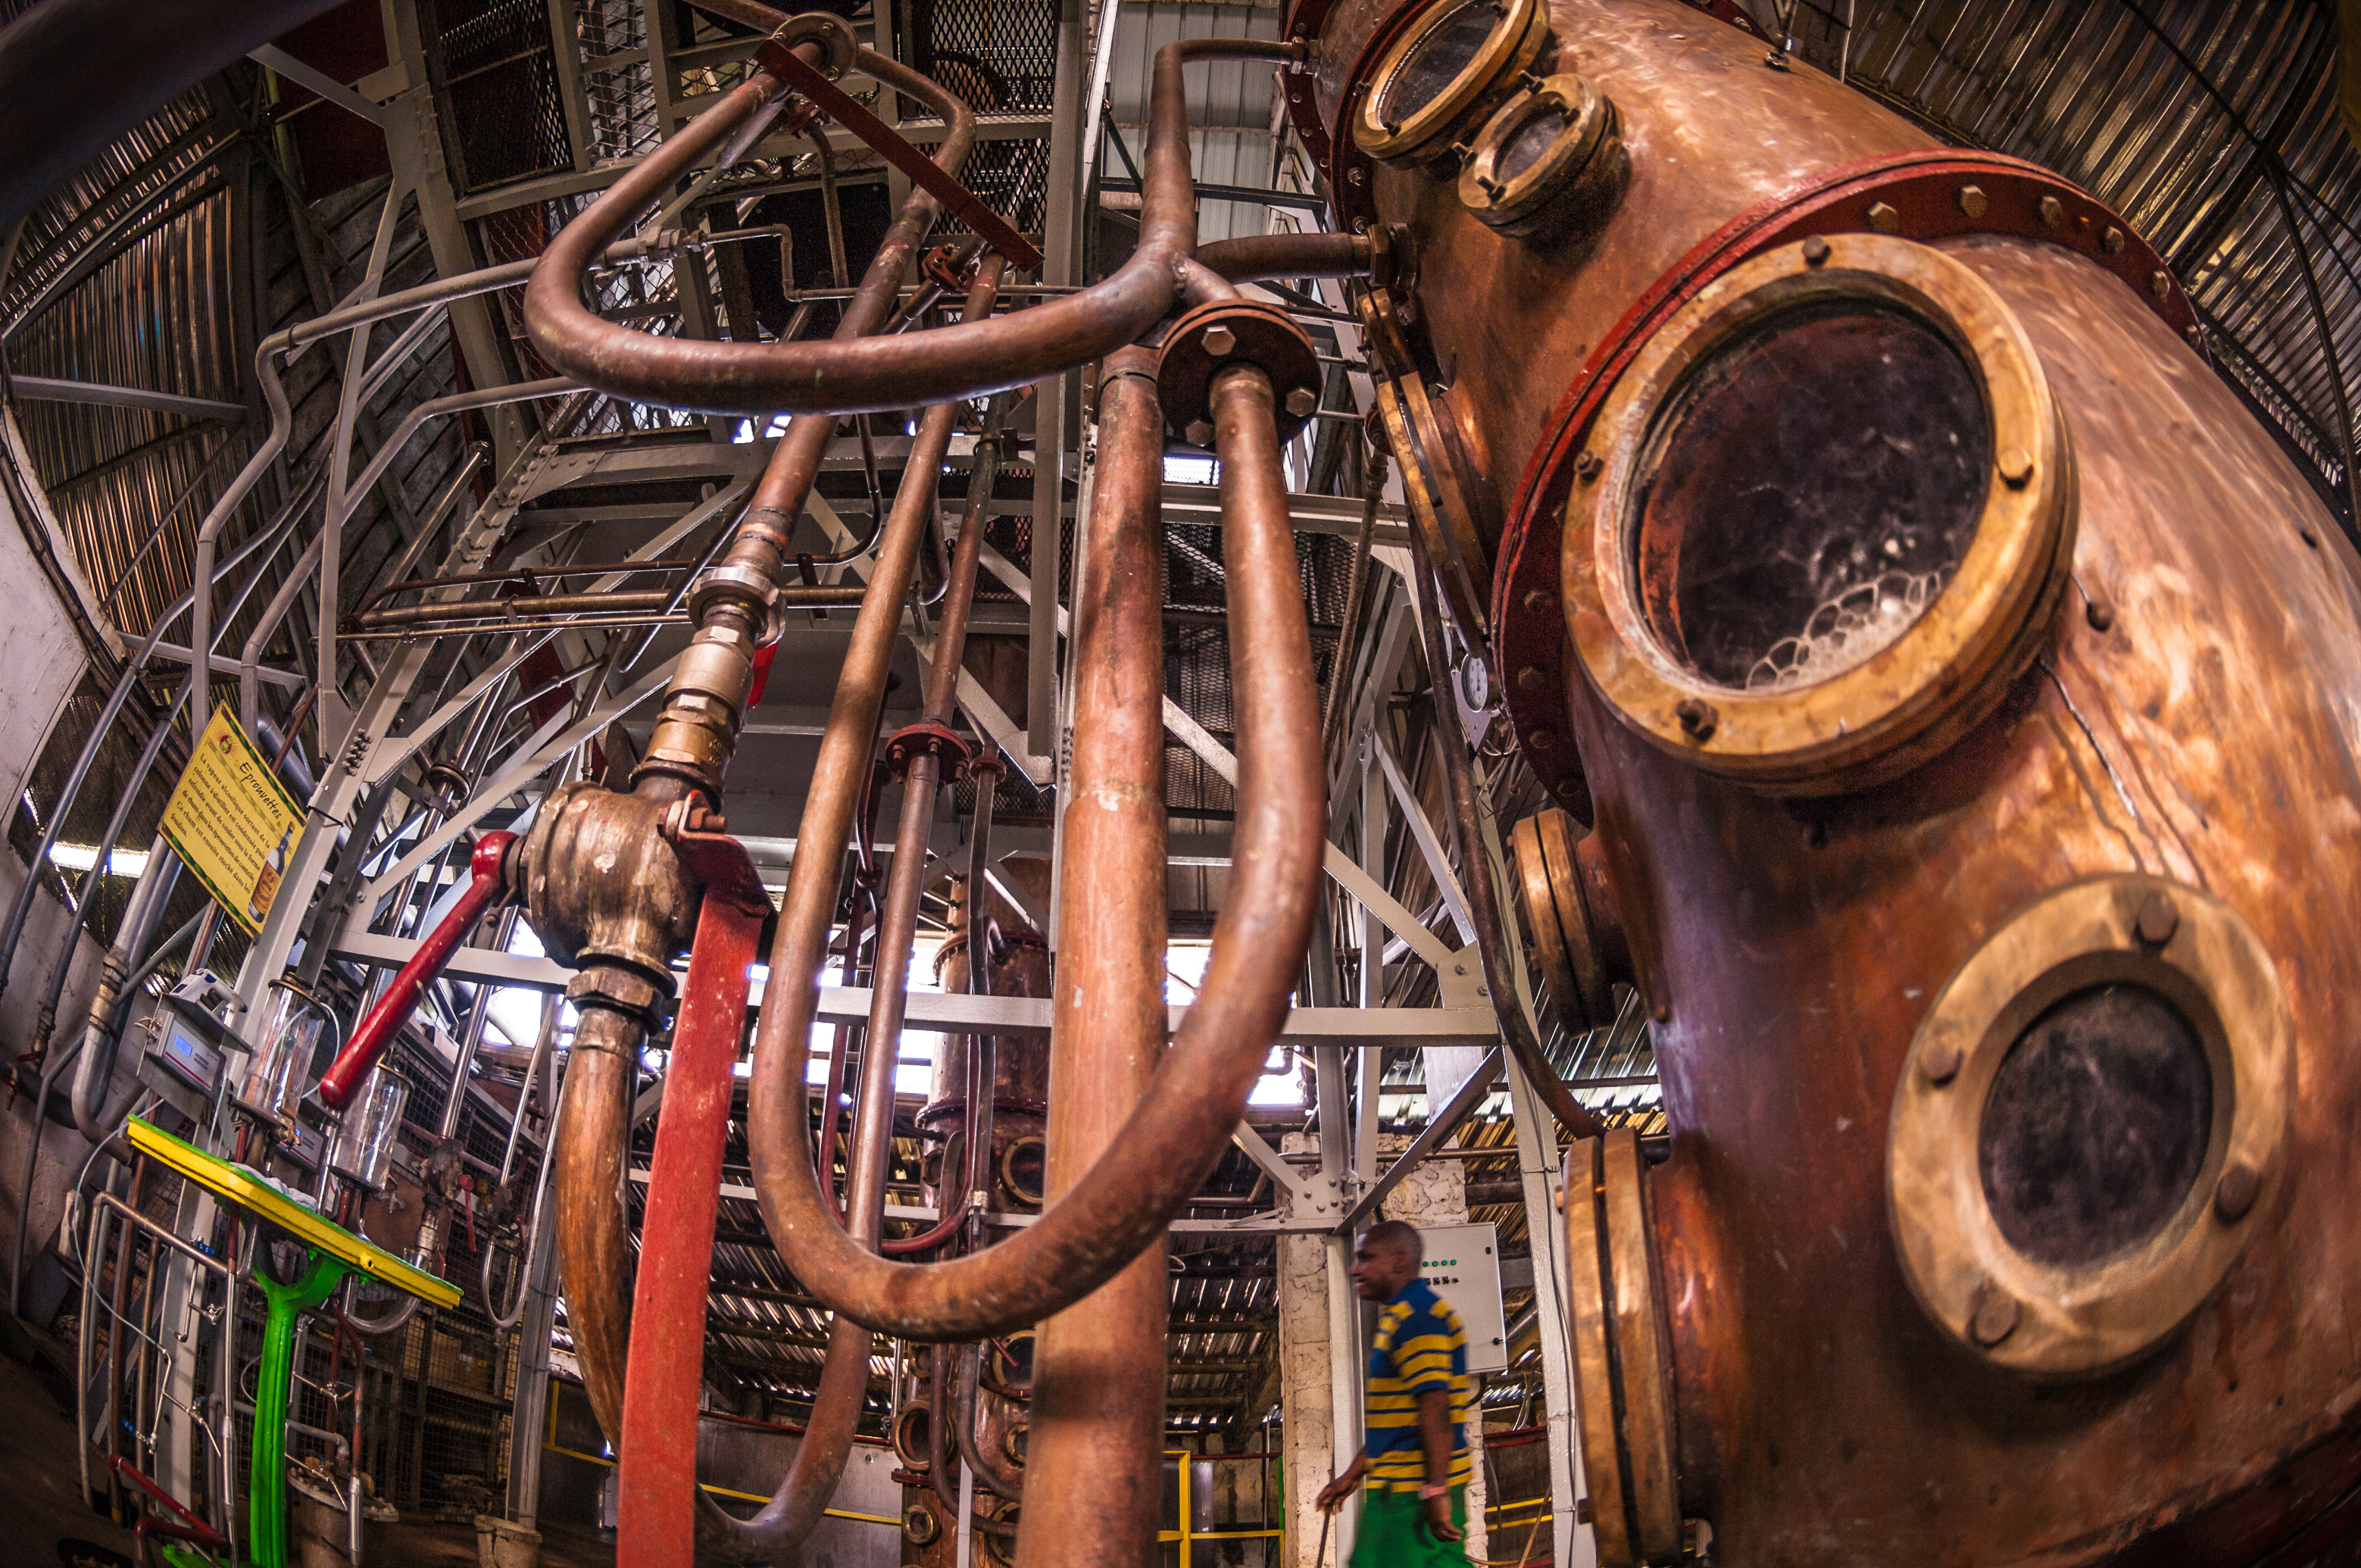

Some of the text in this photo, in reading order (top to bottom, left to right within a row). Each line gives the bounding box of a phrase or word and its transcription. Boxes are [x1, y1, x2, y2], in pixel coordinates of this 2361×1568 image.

[170, 813, 187, 838] foudres.
[183, 789, 188, 798] de
[187, 797, 199, 813] rhum
[198, 811, 208, 825] dans
[213, 829, 234, 858] éprouvettes
[233, 855, 239, 864] de
[188, 778, 261, 871] refroidie avant de couler sous la forme
[194, 767, 211, 789] colonne
[213, 792, 230, 814] distiller
[236, 822, 256, 848] condensée
[255, 848, 265, 860] puis
[200, 753, 270, 848] La vapeur alcoolique sortant de la
[239, 762, 282, 819] Eprouvettes
[176, 801, 183, 812] Ce
[183, 811, 196, 829] rhum
[203, 836, 219, 857] ensuite
[219, 855, 234, 874] stocké
[233, 872, 243, 886] dans
